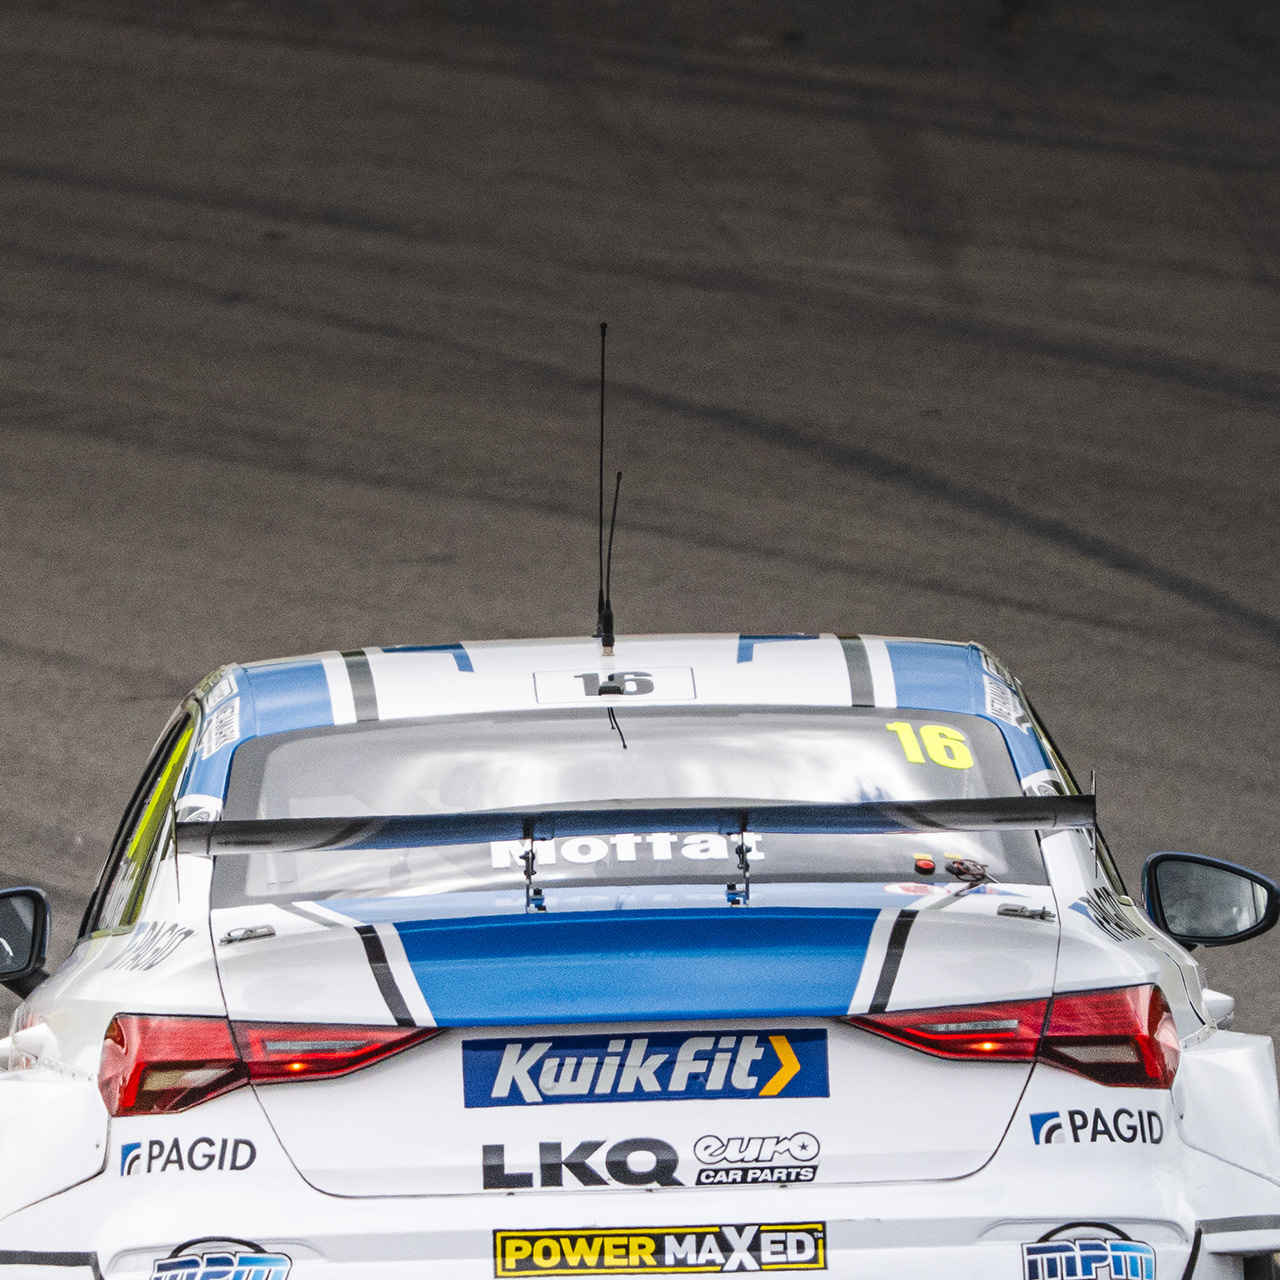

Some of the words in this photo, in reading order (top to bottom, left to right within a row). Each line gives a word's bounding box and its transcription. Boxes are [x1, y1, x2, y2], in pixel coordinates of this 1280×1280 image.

[574, 671, 655, 697] 16
[886, 721, 974, 770] 16
[490, 832, 765, 869] Moffat
[1067, 1107, 1164, 1145] PAGID
[146, 1136, 257, 1173] PAGID
[482, 1137, 687, 1190] LKQ
[693, 1131, 821, 1165] euro
[700, 1169, 743, 1184] CAR
[746, 1167, 815, 1183] PARTS
[504, 1236, 658, 1269] POWER
